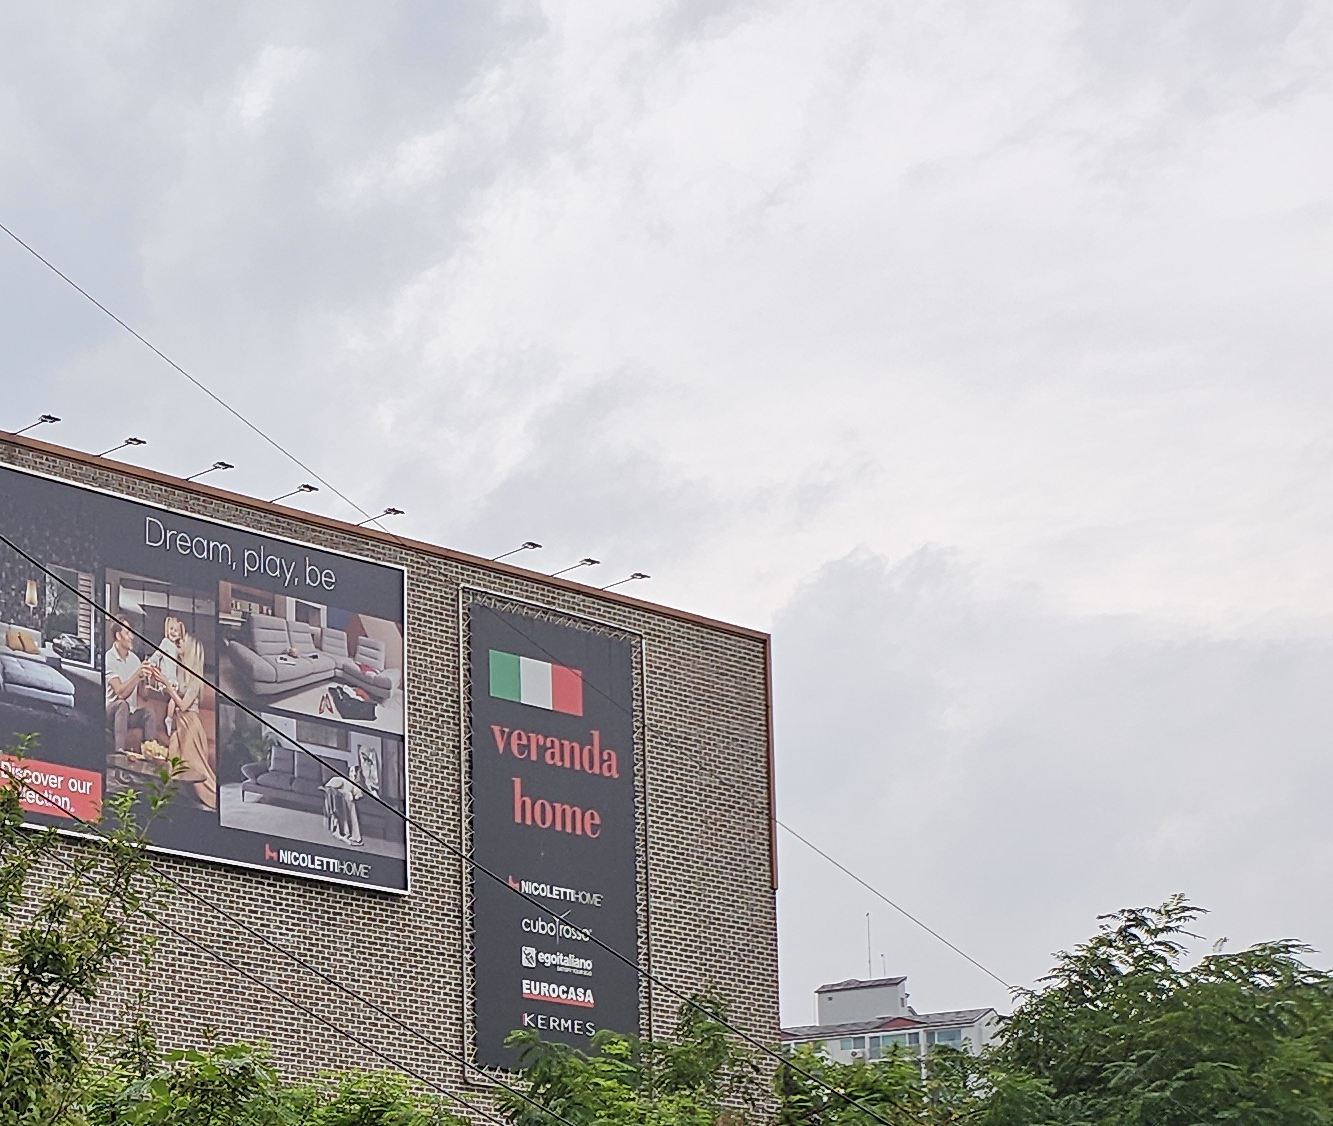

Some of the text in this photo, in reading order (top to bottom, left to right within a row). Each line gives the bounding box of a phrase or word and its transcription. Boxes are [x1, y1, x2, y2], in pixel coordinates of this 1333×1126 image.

[145, 516, 336, 590] Dream, play, be
[490, 724, 620, 779] veranda
[0, 760, 93, 795] Discover our
[511, 777, 602, 838] home
[537, 950, 593, 971] egoitaliano
[521, 979, 595, 1004] EUROCASA
[522, 1011, 597, 1037] KERMES
